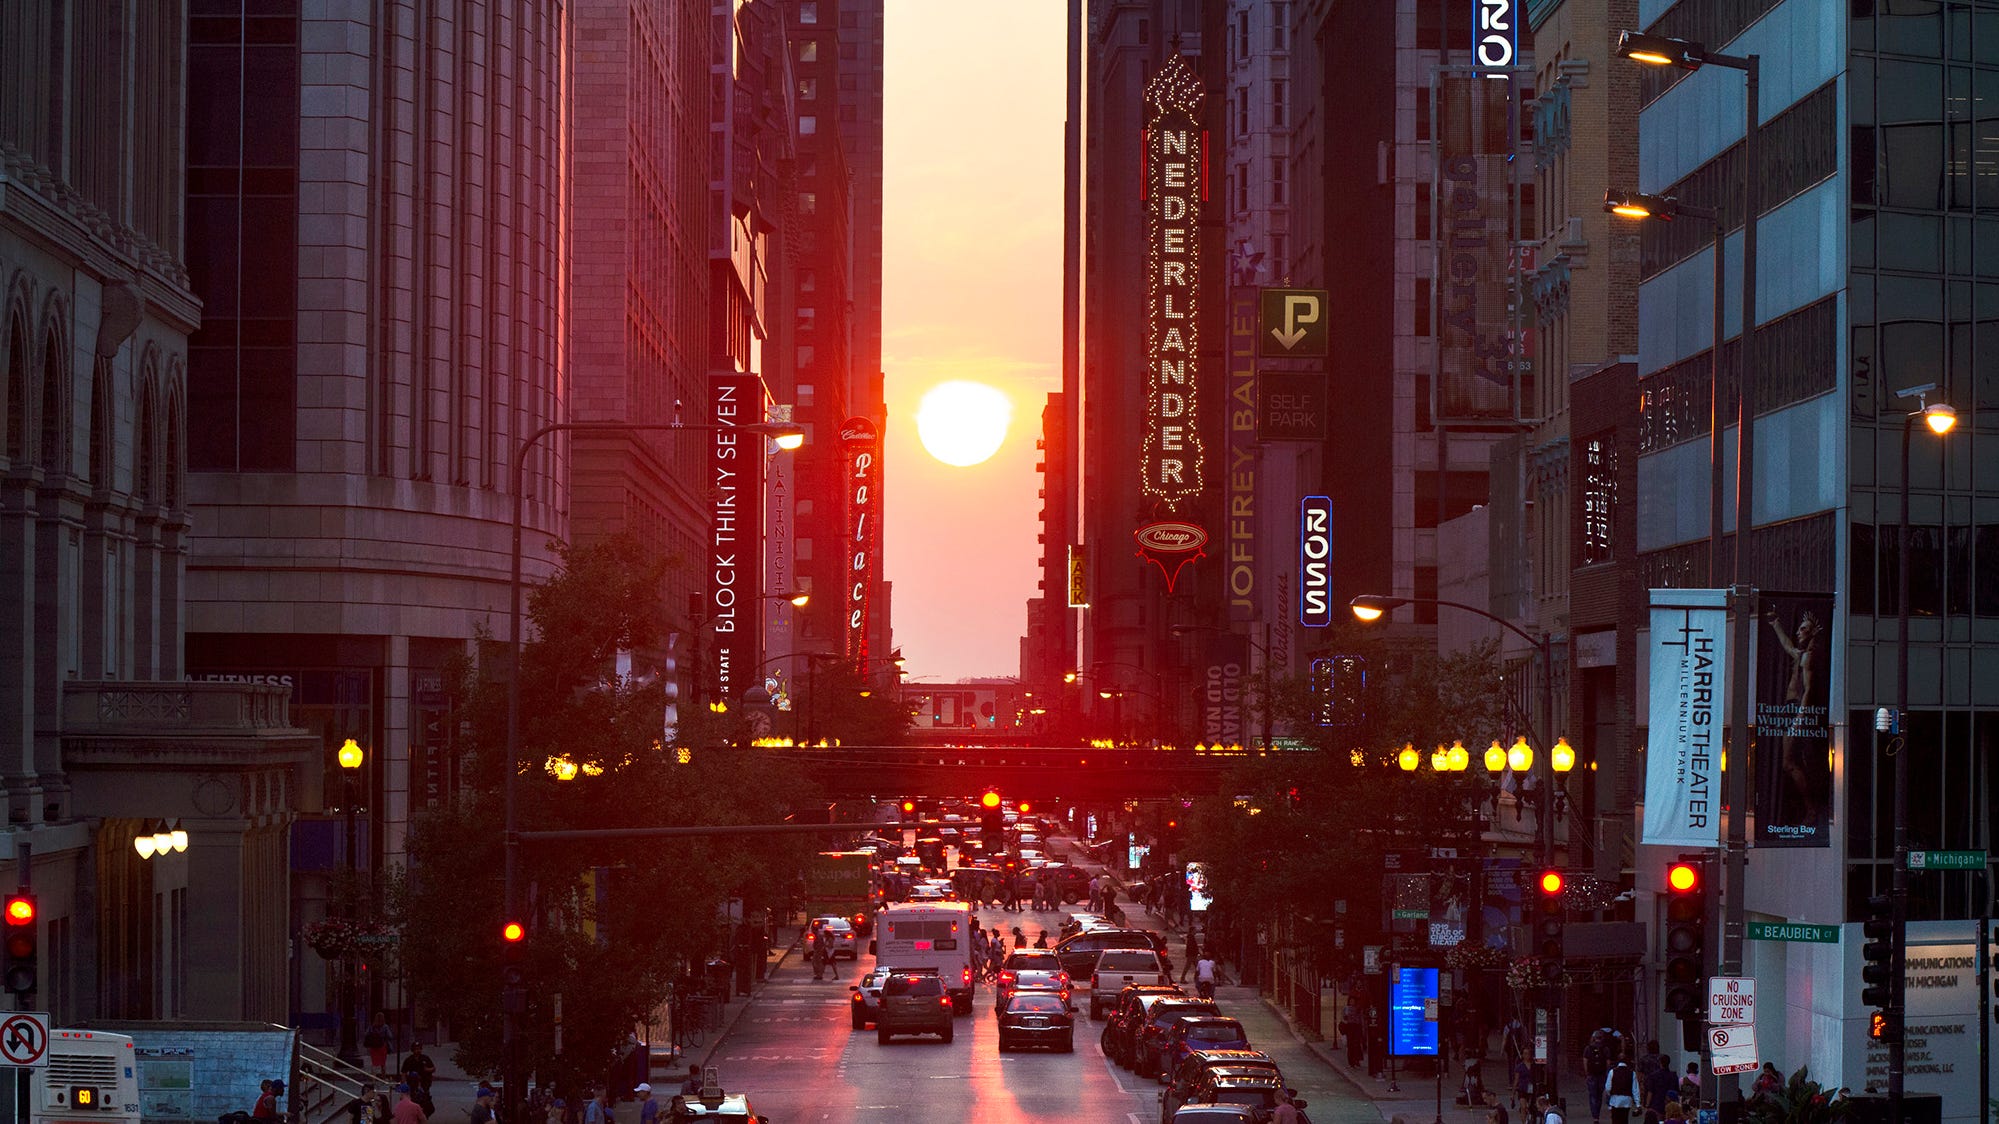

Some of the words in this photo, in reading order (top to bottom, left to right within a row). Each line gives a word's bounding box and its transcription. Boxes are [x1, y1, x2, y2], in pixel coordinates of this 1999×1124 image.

[1478, 0, 1513, 80] RO
[1445, 153, 1487, 335] gallery
[1161, 130, 1187, 485] NEDERLANDER
[1270, 395, 1311, 409] SELF
[1269, 412, 1316, 427] PARK
[772, 465, 787, 616] LATINICITY
[850, 453, 872, 629] Palace
[1153, 530, 1191, 545] Chicago
[1231, 445, 1255, 617] JOFFREY
[1304, 507, 1330, 616] ROSS
[715, 553, 737, 633] BLOCK
[1271, 571, 1294, 668] Walgreens
[720, 648, 730, 682] STATE
[206, 674, 294, 687] FITNESS
[1207, 665, 1222, 702] OLD
[1223, 663, 1241, 701] OLD
[1691, 638, 1714, 727] HARRIS
[1678, 659, 1689, 744] MILLENNIUM
[1757, 703, 1828, 715] Tanztheater
[1207, 706, 1222, 743] NAV
[1223, 706, 1241, 744] NAV
[1757, 714, 1819, 728] Wuppertal
[1757, 727, 1784, 737] Pina
[1786, 726, 1829, 738] Bausch
[1675, 750, 1687, 784] PARK
[1688, 729, 1711, 829] THEATER
[1767, 825, 1799, 835] Sterling
[1799, 825, 1817, 835] Bay
[1933, 853, 1975, 868] Michigan
[1401, 911, 1429, 919] Garland
[1764, 926, 1821, 940] BEAUBIEN
[1904, 956, 1974, 970] OMMUNICATIONS
[1726, 982, 1739, 993] NO
[1916, 974, 1958, 989] MICHIGAN
[1712, 995, 1754, 1006] CRUISING
[1721, 1008, 1744, 1019] ZONE
[1716, 1065, 1733, 1075] TOW
[1735, 1062, 1755, 1072] ZONE
[78, 1089, 91, 1104] 60
